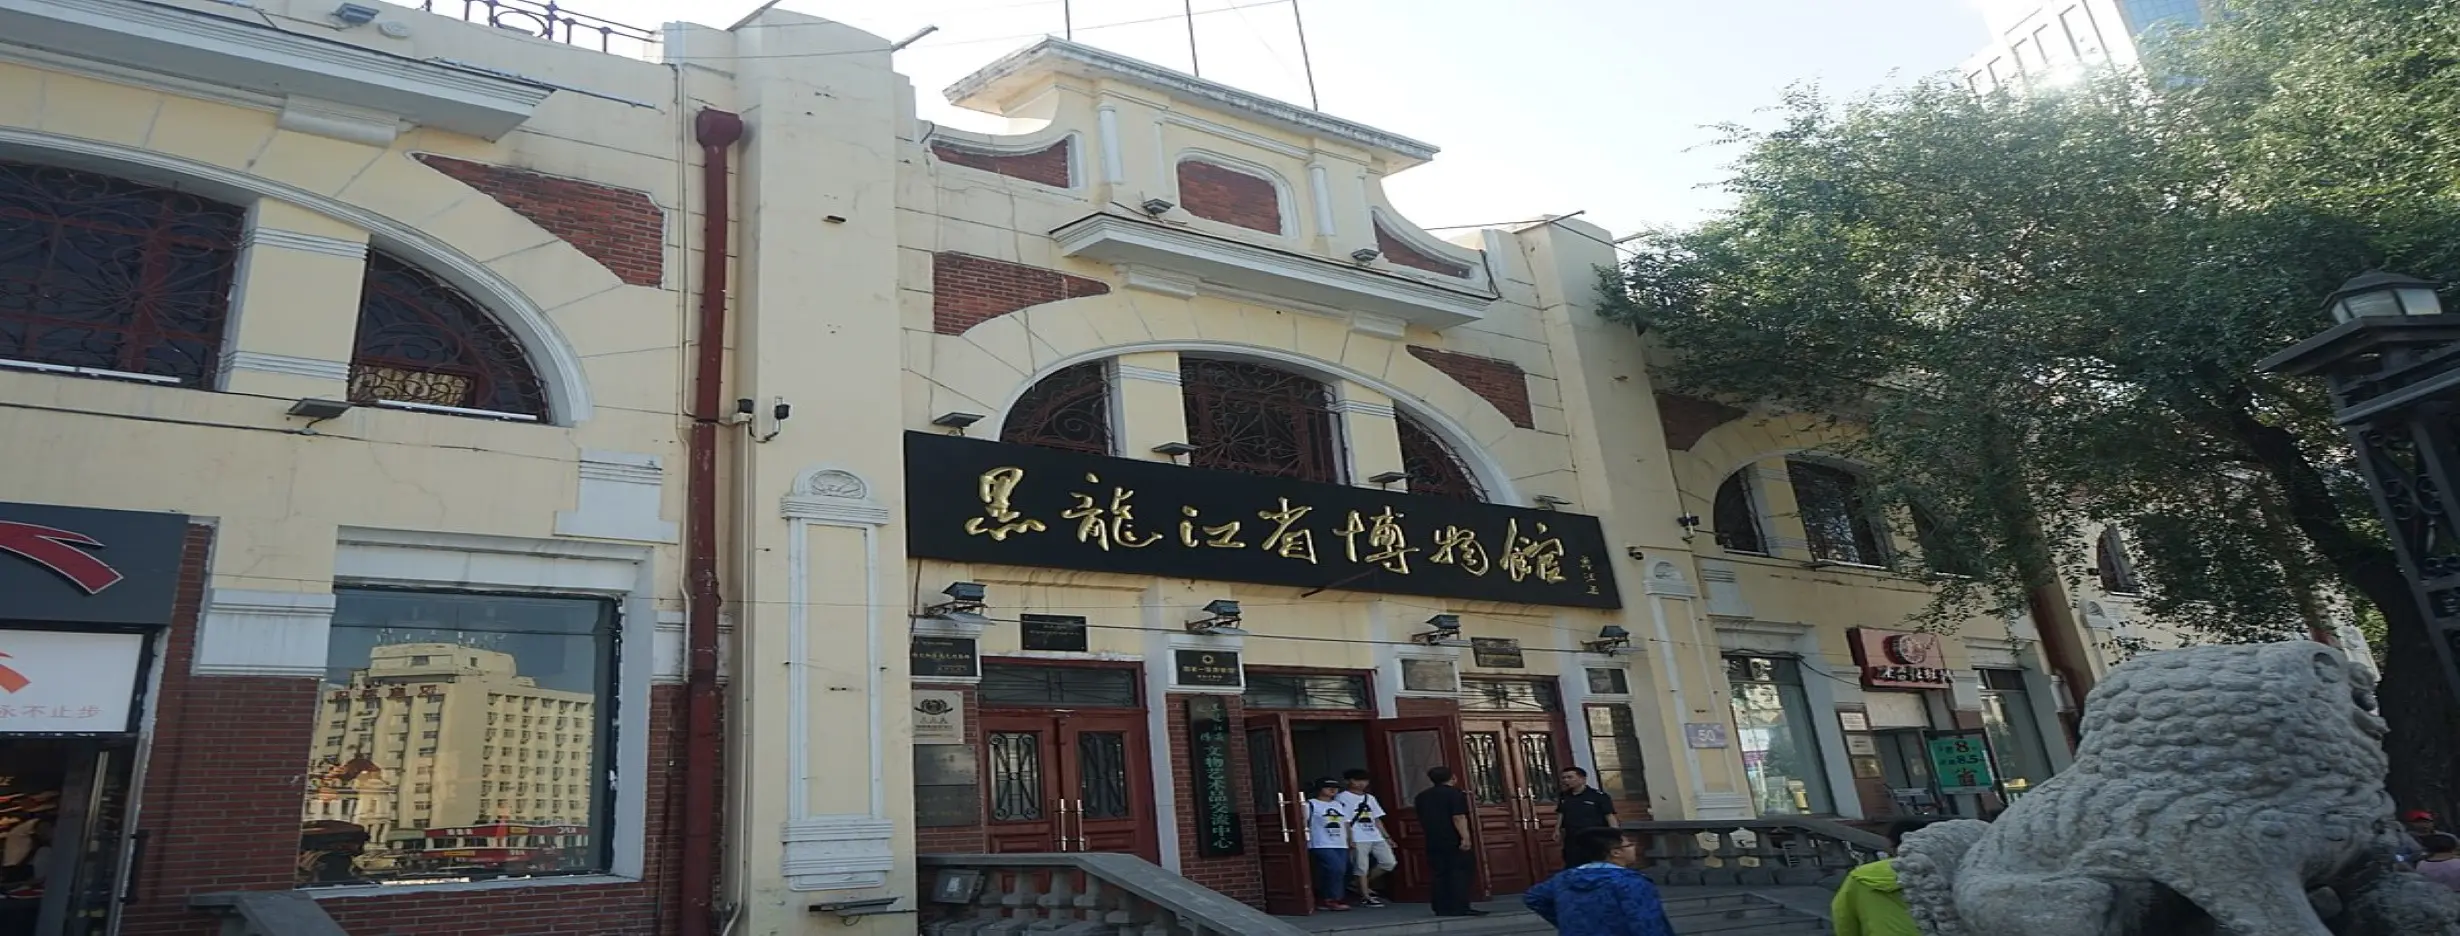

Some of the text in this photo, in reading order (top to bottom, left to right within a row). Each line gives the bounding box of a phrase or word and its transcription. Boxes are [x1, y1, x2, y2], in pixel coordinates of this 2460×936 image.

[1698, 729, 1716, 742] 50
[1205, 745, 1234, 849] 文物艺术品交流中心
